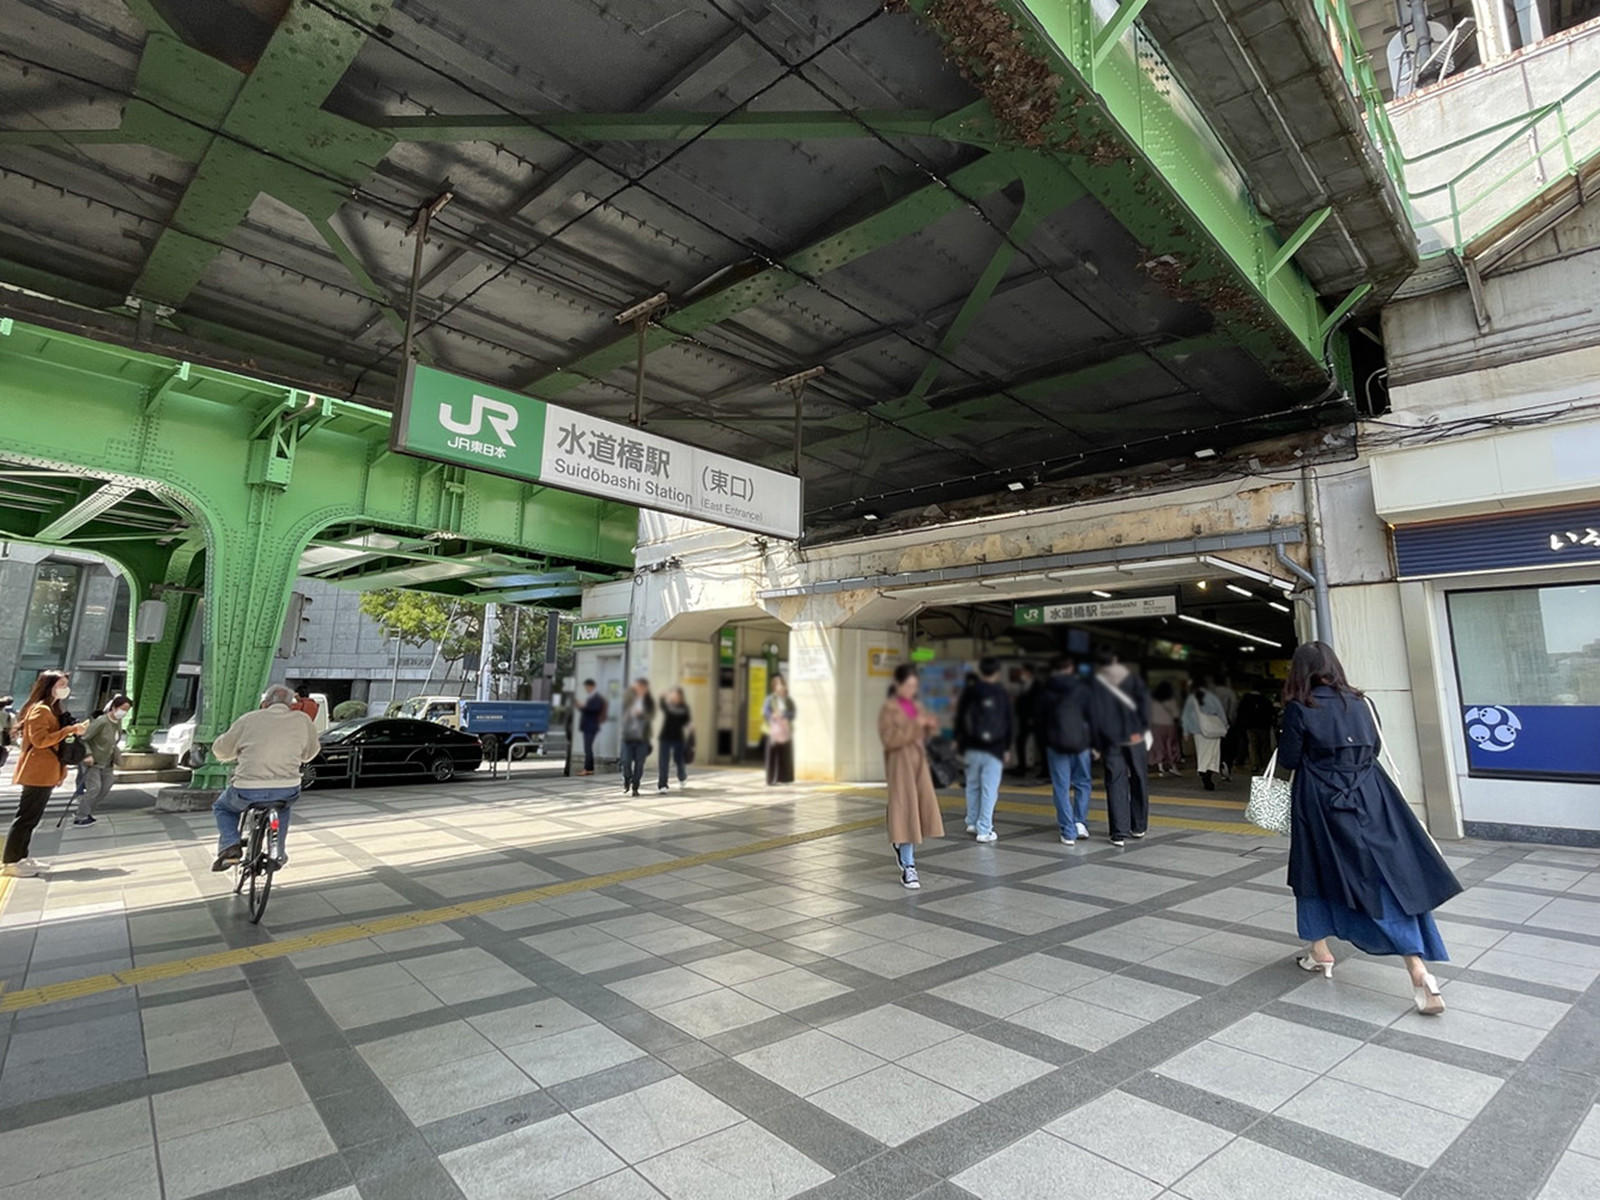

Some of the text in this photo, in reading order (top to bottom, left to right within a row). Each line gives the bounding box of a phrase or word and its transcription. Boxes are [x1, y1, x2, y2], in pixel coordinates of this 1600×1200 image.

[438, 394, 519, 448] JR
[447, 436, 508, 459] JR東日本
[556, 422, 754, 502] 水道橋駅 (東口)
[554, 458, 693, 506] Suidōbashi Station
[700, 497, 764, 521] (East Entrance)
[1023, 608, 1040, 620] JR
[1049, 604, 1098, 621] 水道橋駅
[576, 623, 624, 641] NewDays
